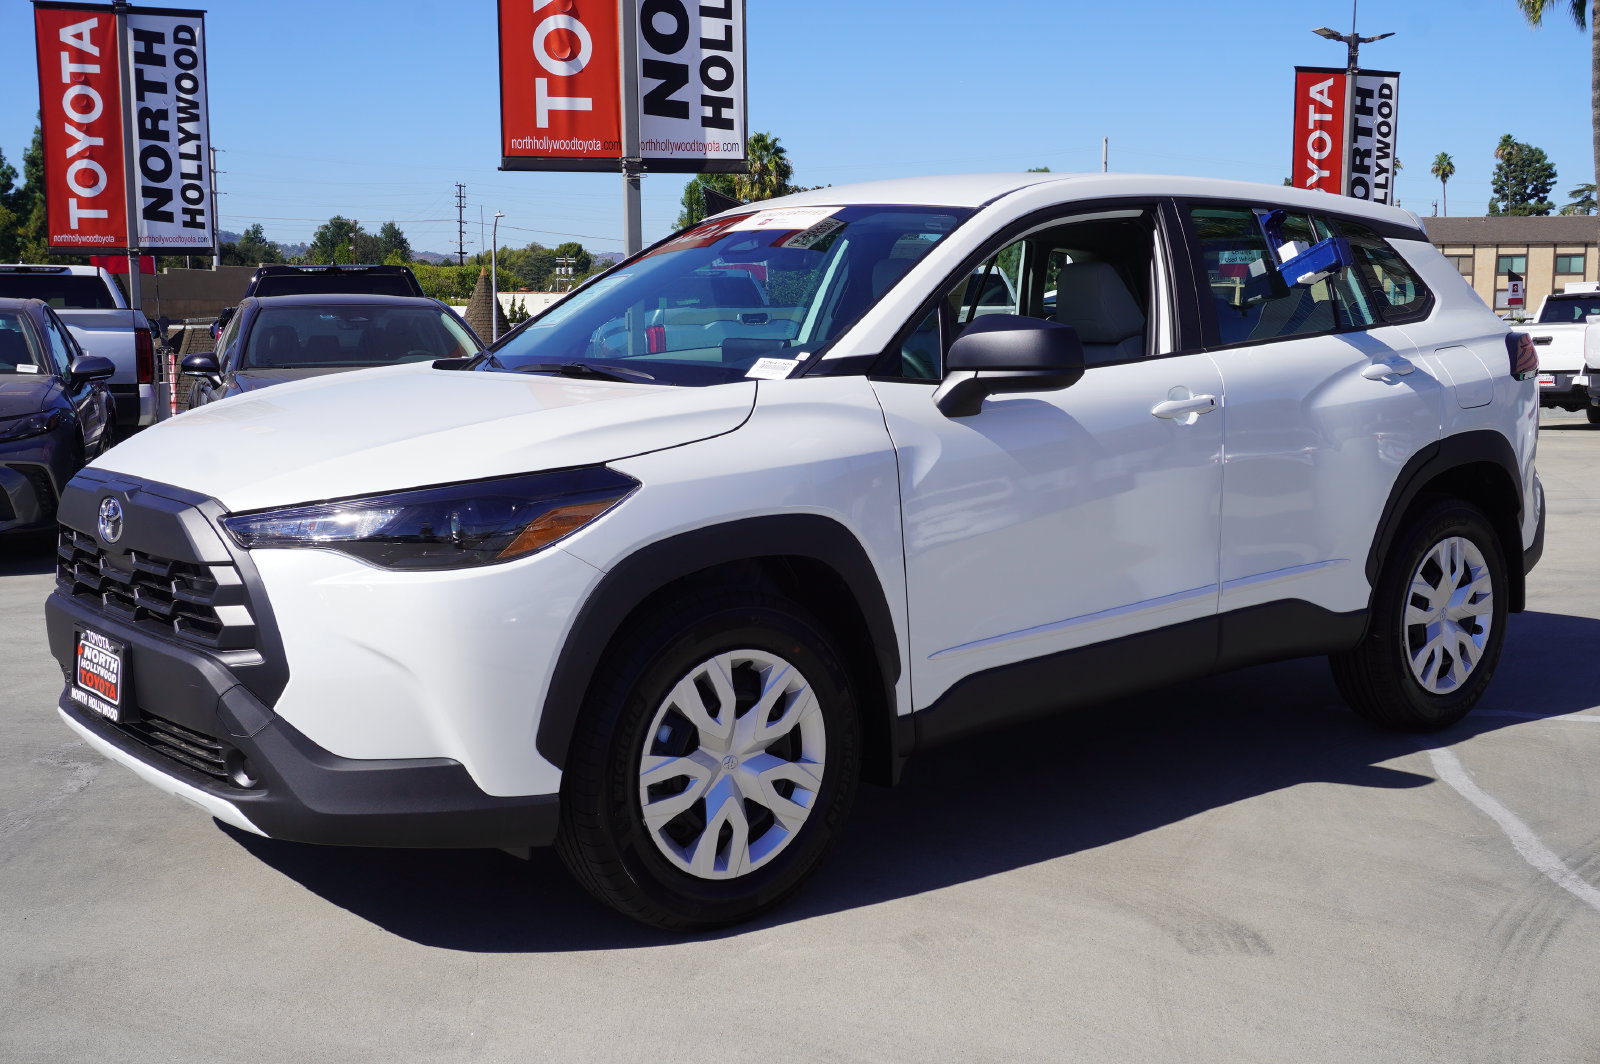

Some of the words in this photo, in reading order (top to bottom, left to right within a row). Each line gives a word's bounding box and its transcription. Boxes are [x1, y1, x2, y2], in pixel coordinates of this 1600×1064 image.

[532, 0, 593, 128] TO
[59, 17, 109, 230] TOYOTA
[133, 28, 175, 224] NORTH
[173, 24, 206, 230] HOLLYWOOD
[1306, 77, 1334, 193] YOTA
[639, 138, 740, 155] orthhollywoodtoyota.com
[86, 629, 110, 650] TOYOTA
[80, 658, 117, 684] HOLLYWOOD
[83, 645, 118, 673] NORTH
[80, 669, 117, 700] TOYOTA
[71, 687, 88, 705] NORTH
[88, 696, 118, 722] HOLLYWOOD
